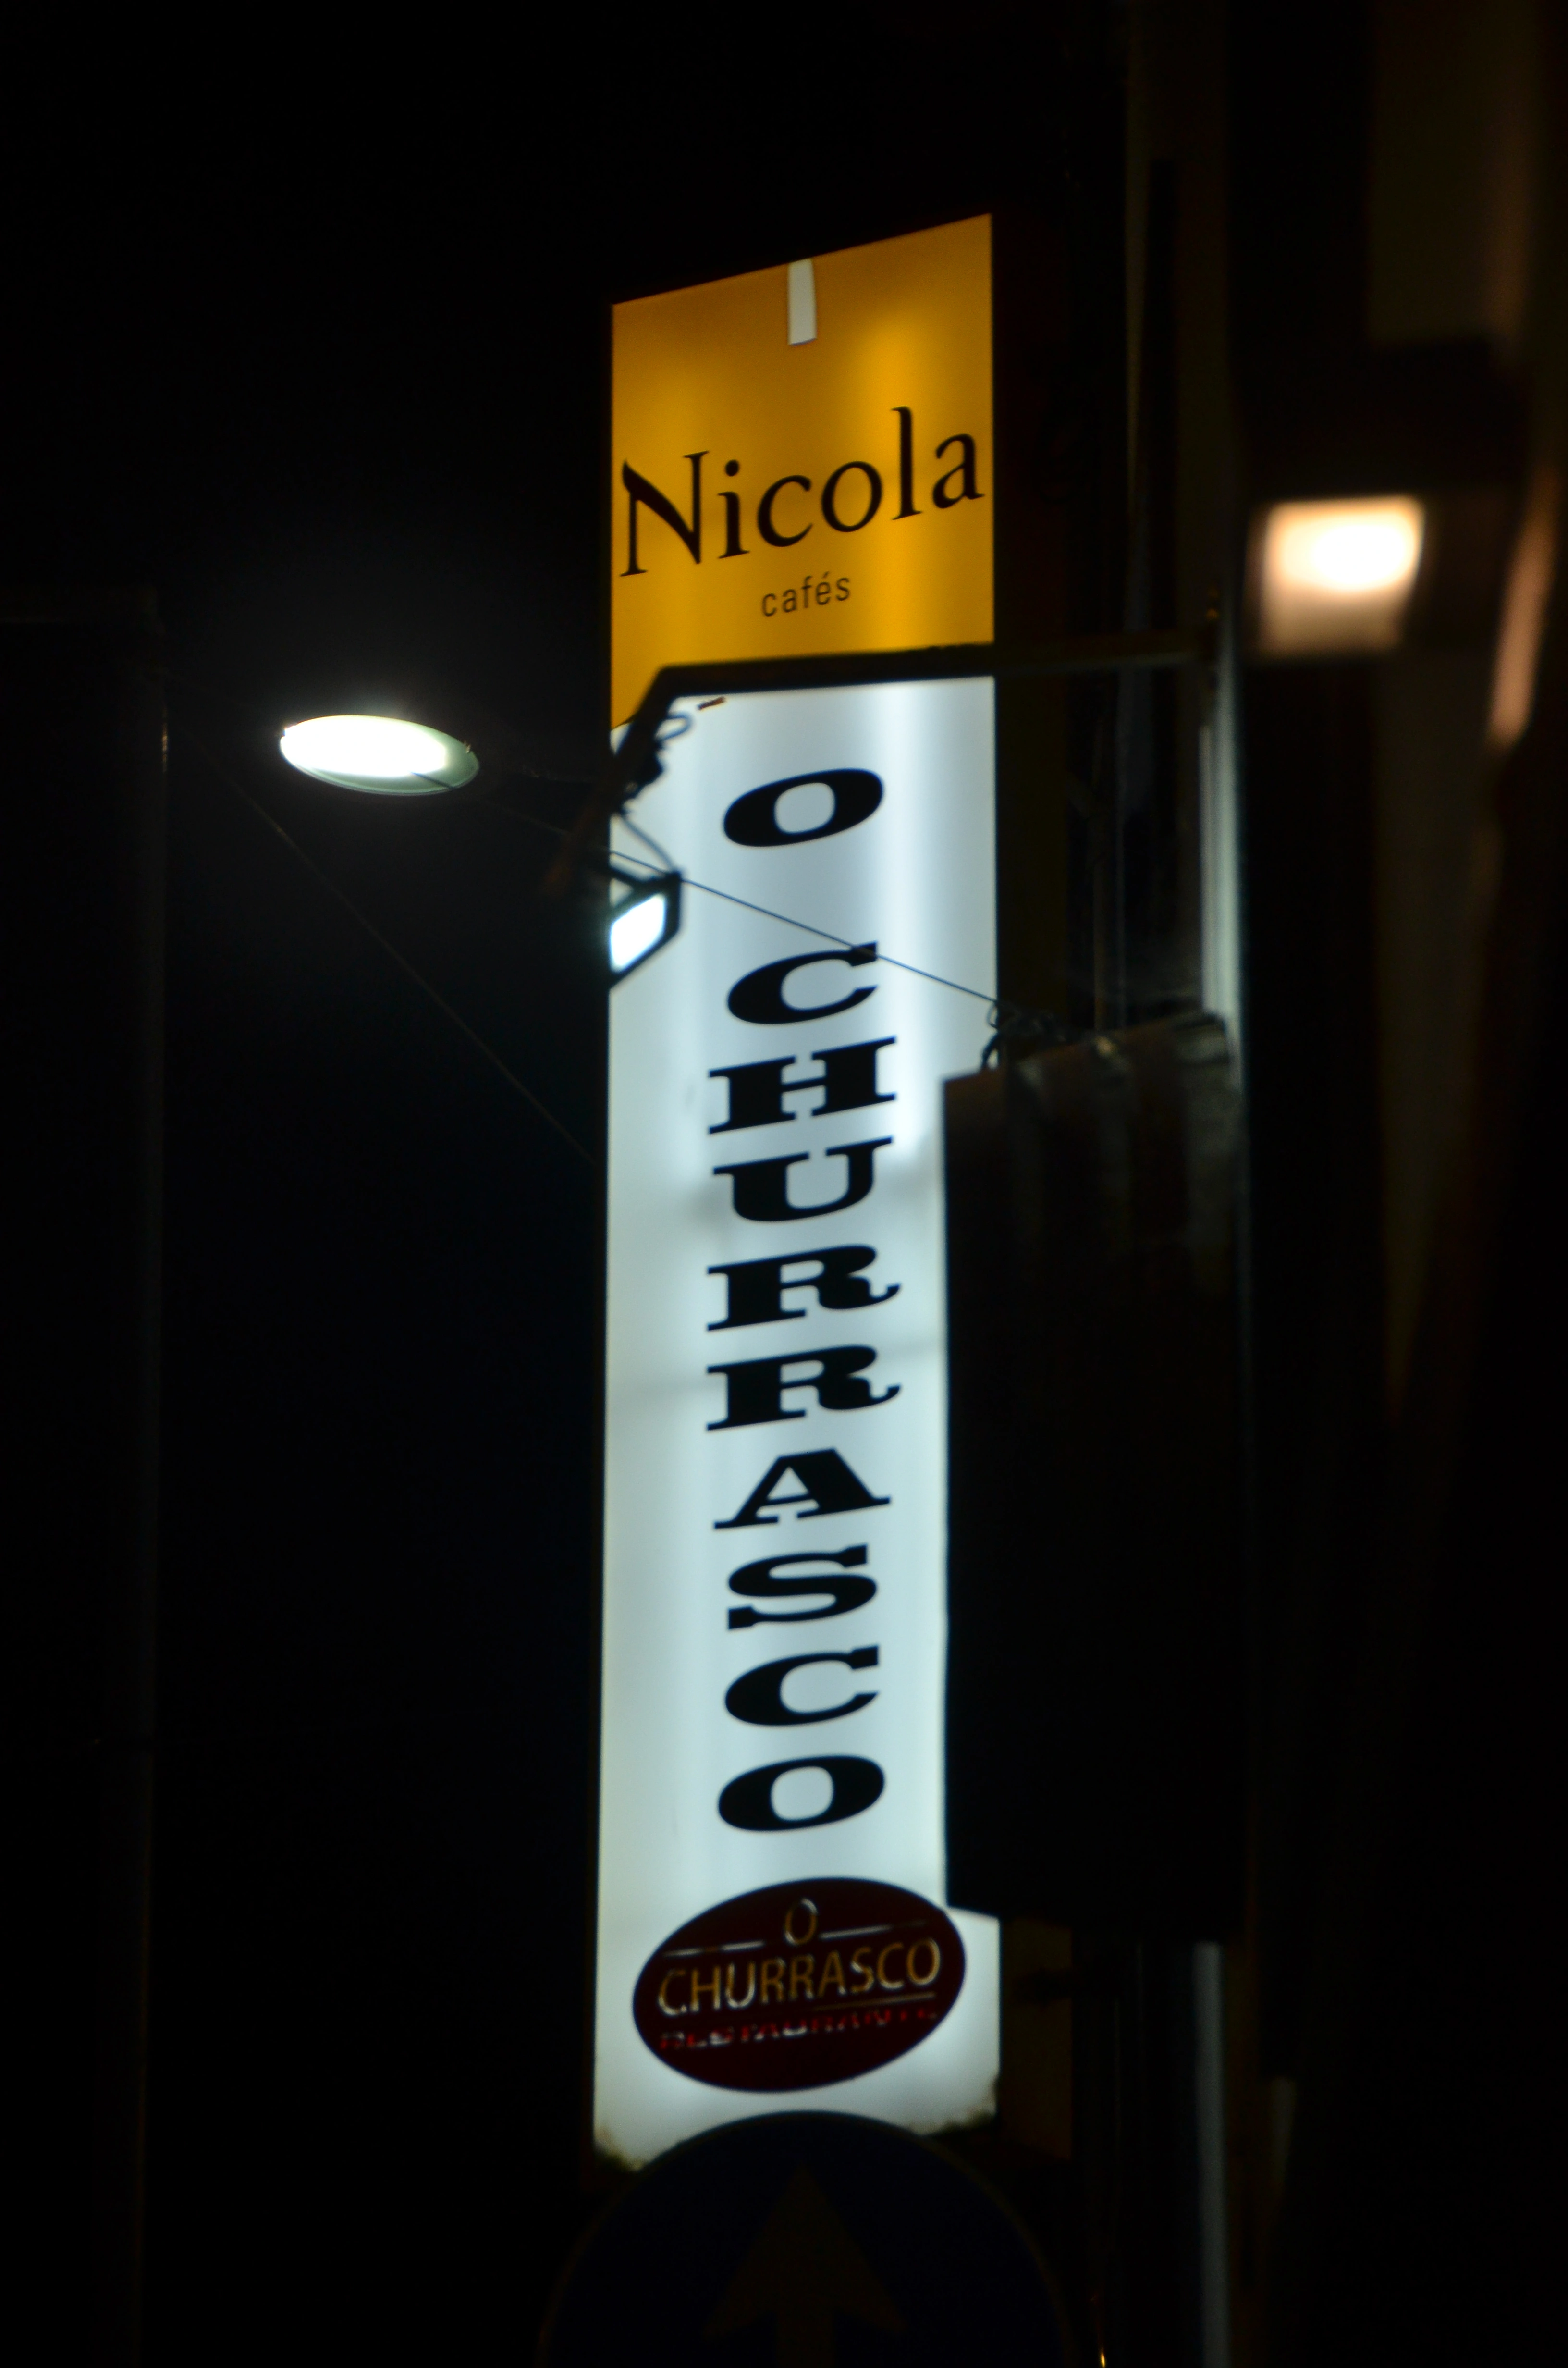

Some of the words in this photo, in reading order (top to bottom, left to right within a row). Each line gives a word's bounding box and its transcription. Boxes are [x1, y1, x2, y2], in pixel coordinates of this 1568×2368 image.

[620, 406, 985, 577] Nicola
[760, 571, 851, 617] cafés
[723, 768, 883, 848] O
[707, 941, 900, 1833] CHURRASCO
[784, 1897, 820, 1948] O
[656, 1937, 943, 2017] CHURRASCO
